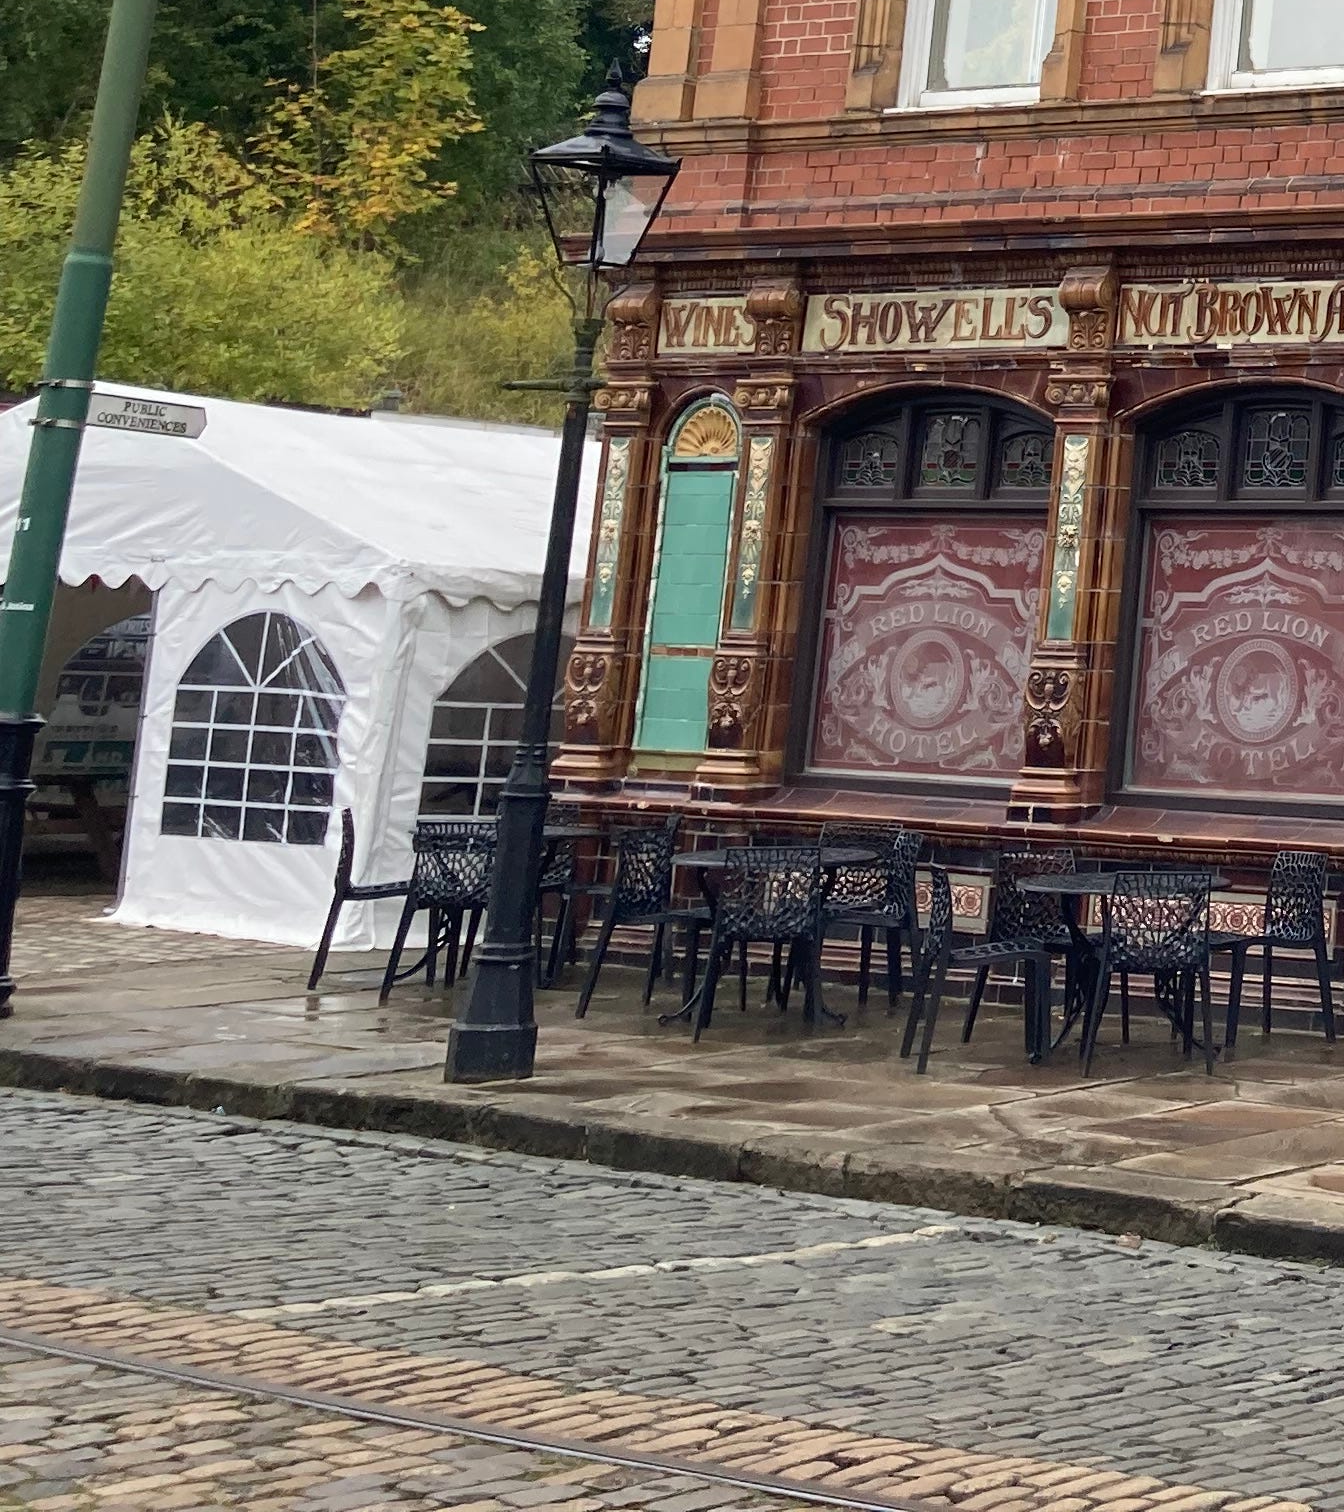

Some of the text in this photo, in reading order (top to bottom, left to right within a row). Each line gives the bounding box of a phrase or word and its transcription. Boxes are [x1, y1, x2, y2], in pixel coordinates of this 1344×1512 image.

[662, 301, 757, 348] WINES
[819, 294, 1054, 351] SHOWELL'S
[1117, 281, 1195, 339] NUT
[1186, 283, 1320, 344] BROWN
[97, 412, 188, 433] CONVENIENCES
[123, 401, 168, 417] PUBLIC
[869, 603, 995, 638] RED LION
[1191, 611, 1330, 648] RED LION
[867, 712, 978, 758] HOTEL
[1190, 726, 1316, 775] HOTEL
